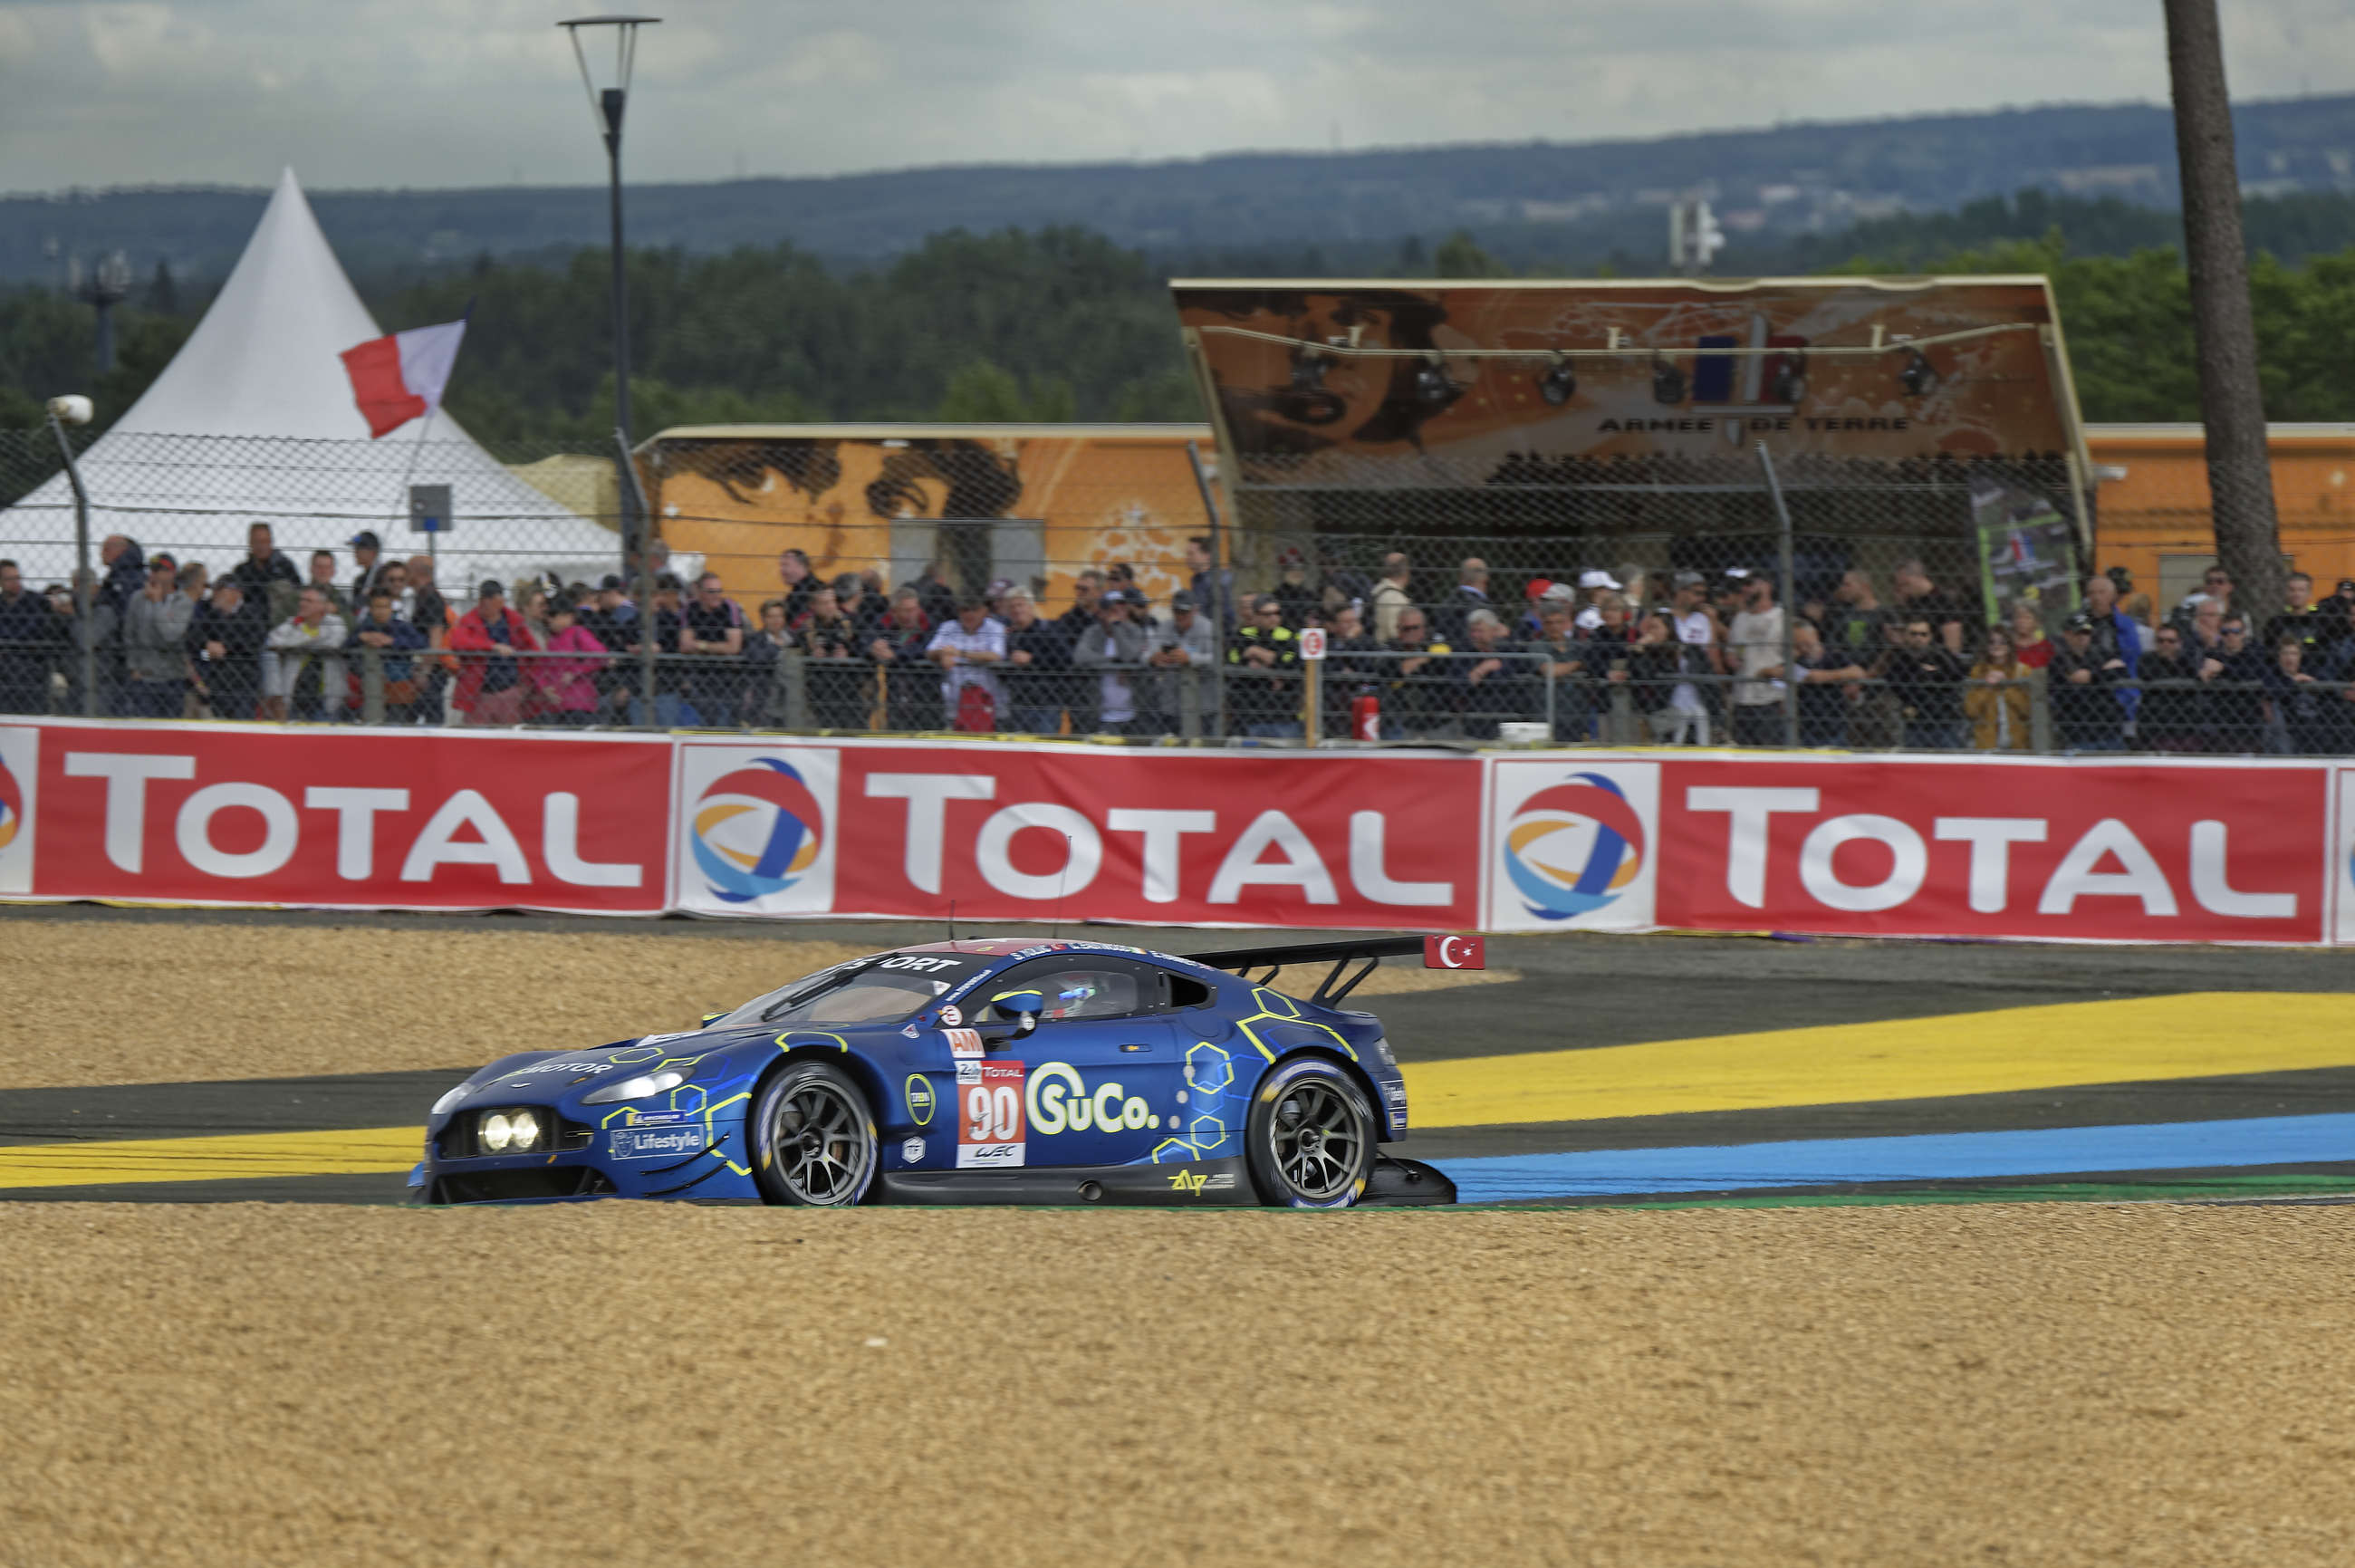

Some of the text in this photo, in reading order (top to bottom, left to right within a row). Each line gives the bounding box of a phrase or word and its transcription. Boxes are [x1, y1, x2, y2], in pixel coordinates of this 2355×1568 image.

[1597, 417, 1909, 432] ARMEE DE TERRE
[64, 751, 643, 888] TOTAL
[865, 773, 1454, 908] TOTAL
[1686, 785, 2297, 918] TOTAL
[950, 1031, 981, 1052] AM
[983, 1066, 1024, 1078] TOTAL
[967, 1086, 1019, 1141] 90
[634, 1130, 700, 1152] Lifestyle
[974, 1145, 1017, 1158] WEC
